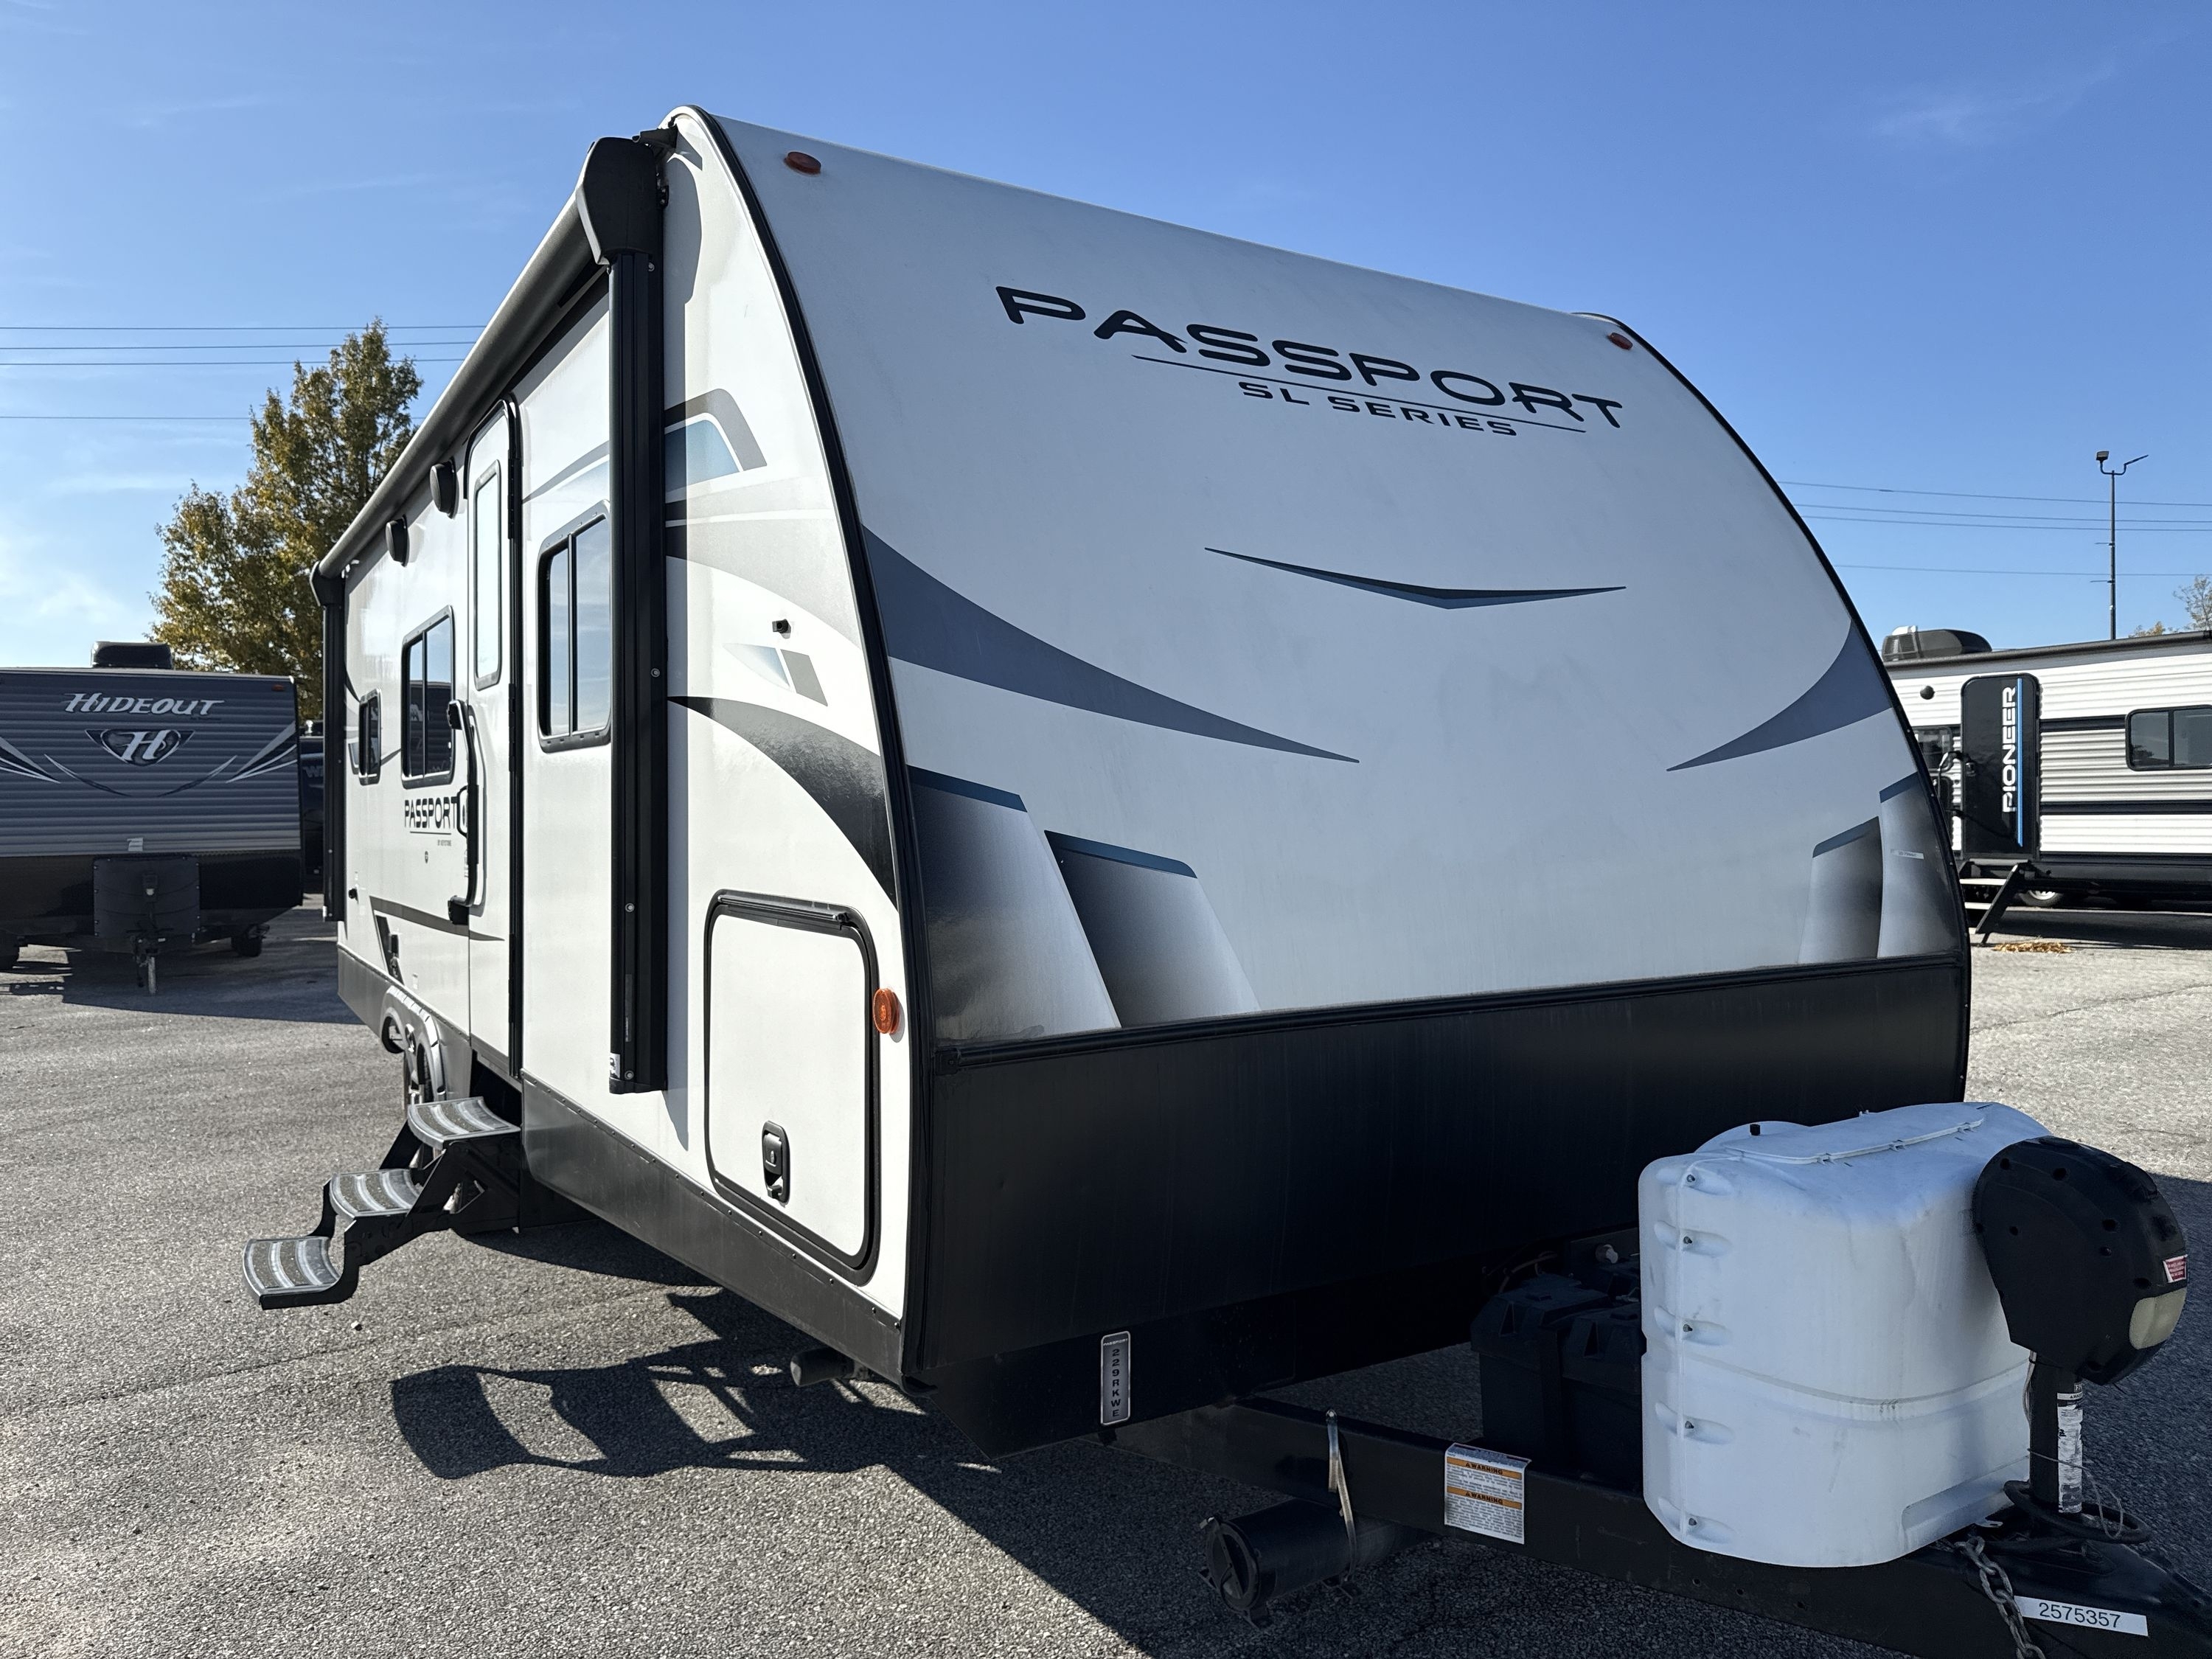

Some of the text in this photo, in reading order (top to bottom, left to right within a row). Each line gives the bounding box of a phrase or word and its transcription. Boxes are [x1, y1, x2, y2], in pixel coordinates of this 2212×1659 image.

[995, 286, 1624, 428] PASSPORT
[1238, 381, 1517, 437] SL SERIES
[64, 692, 225, 716] HIDEOUT
[2002, 687, 2016, 813] PIONEER
[404, 796, 457, 829] PASSPORT
[1111, 1349, 1121, 1417] 229RKWE
[1471, 1463, 1503, 1475] WARNING
[1471, 1492, 1503, 1504] WARNING
[2039, 1602, 2121, 1628] 2575357
